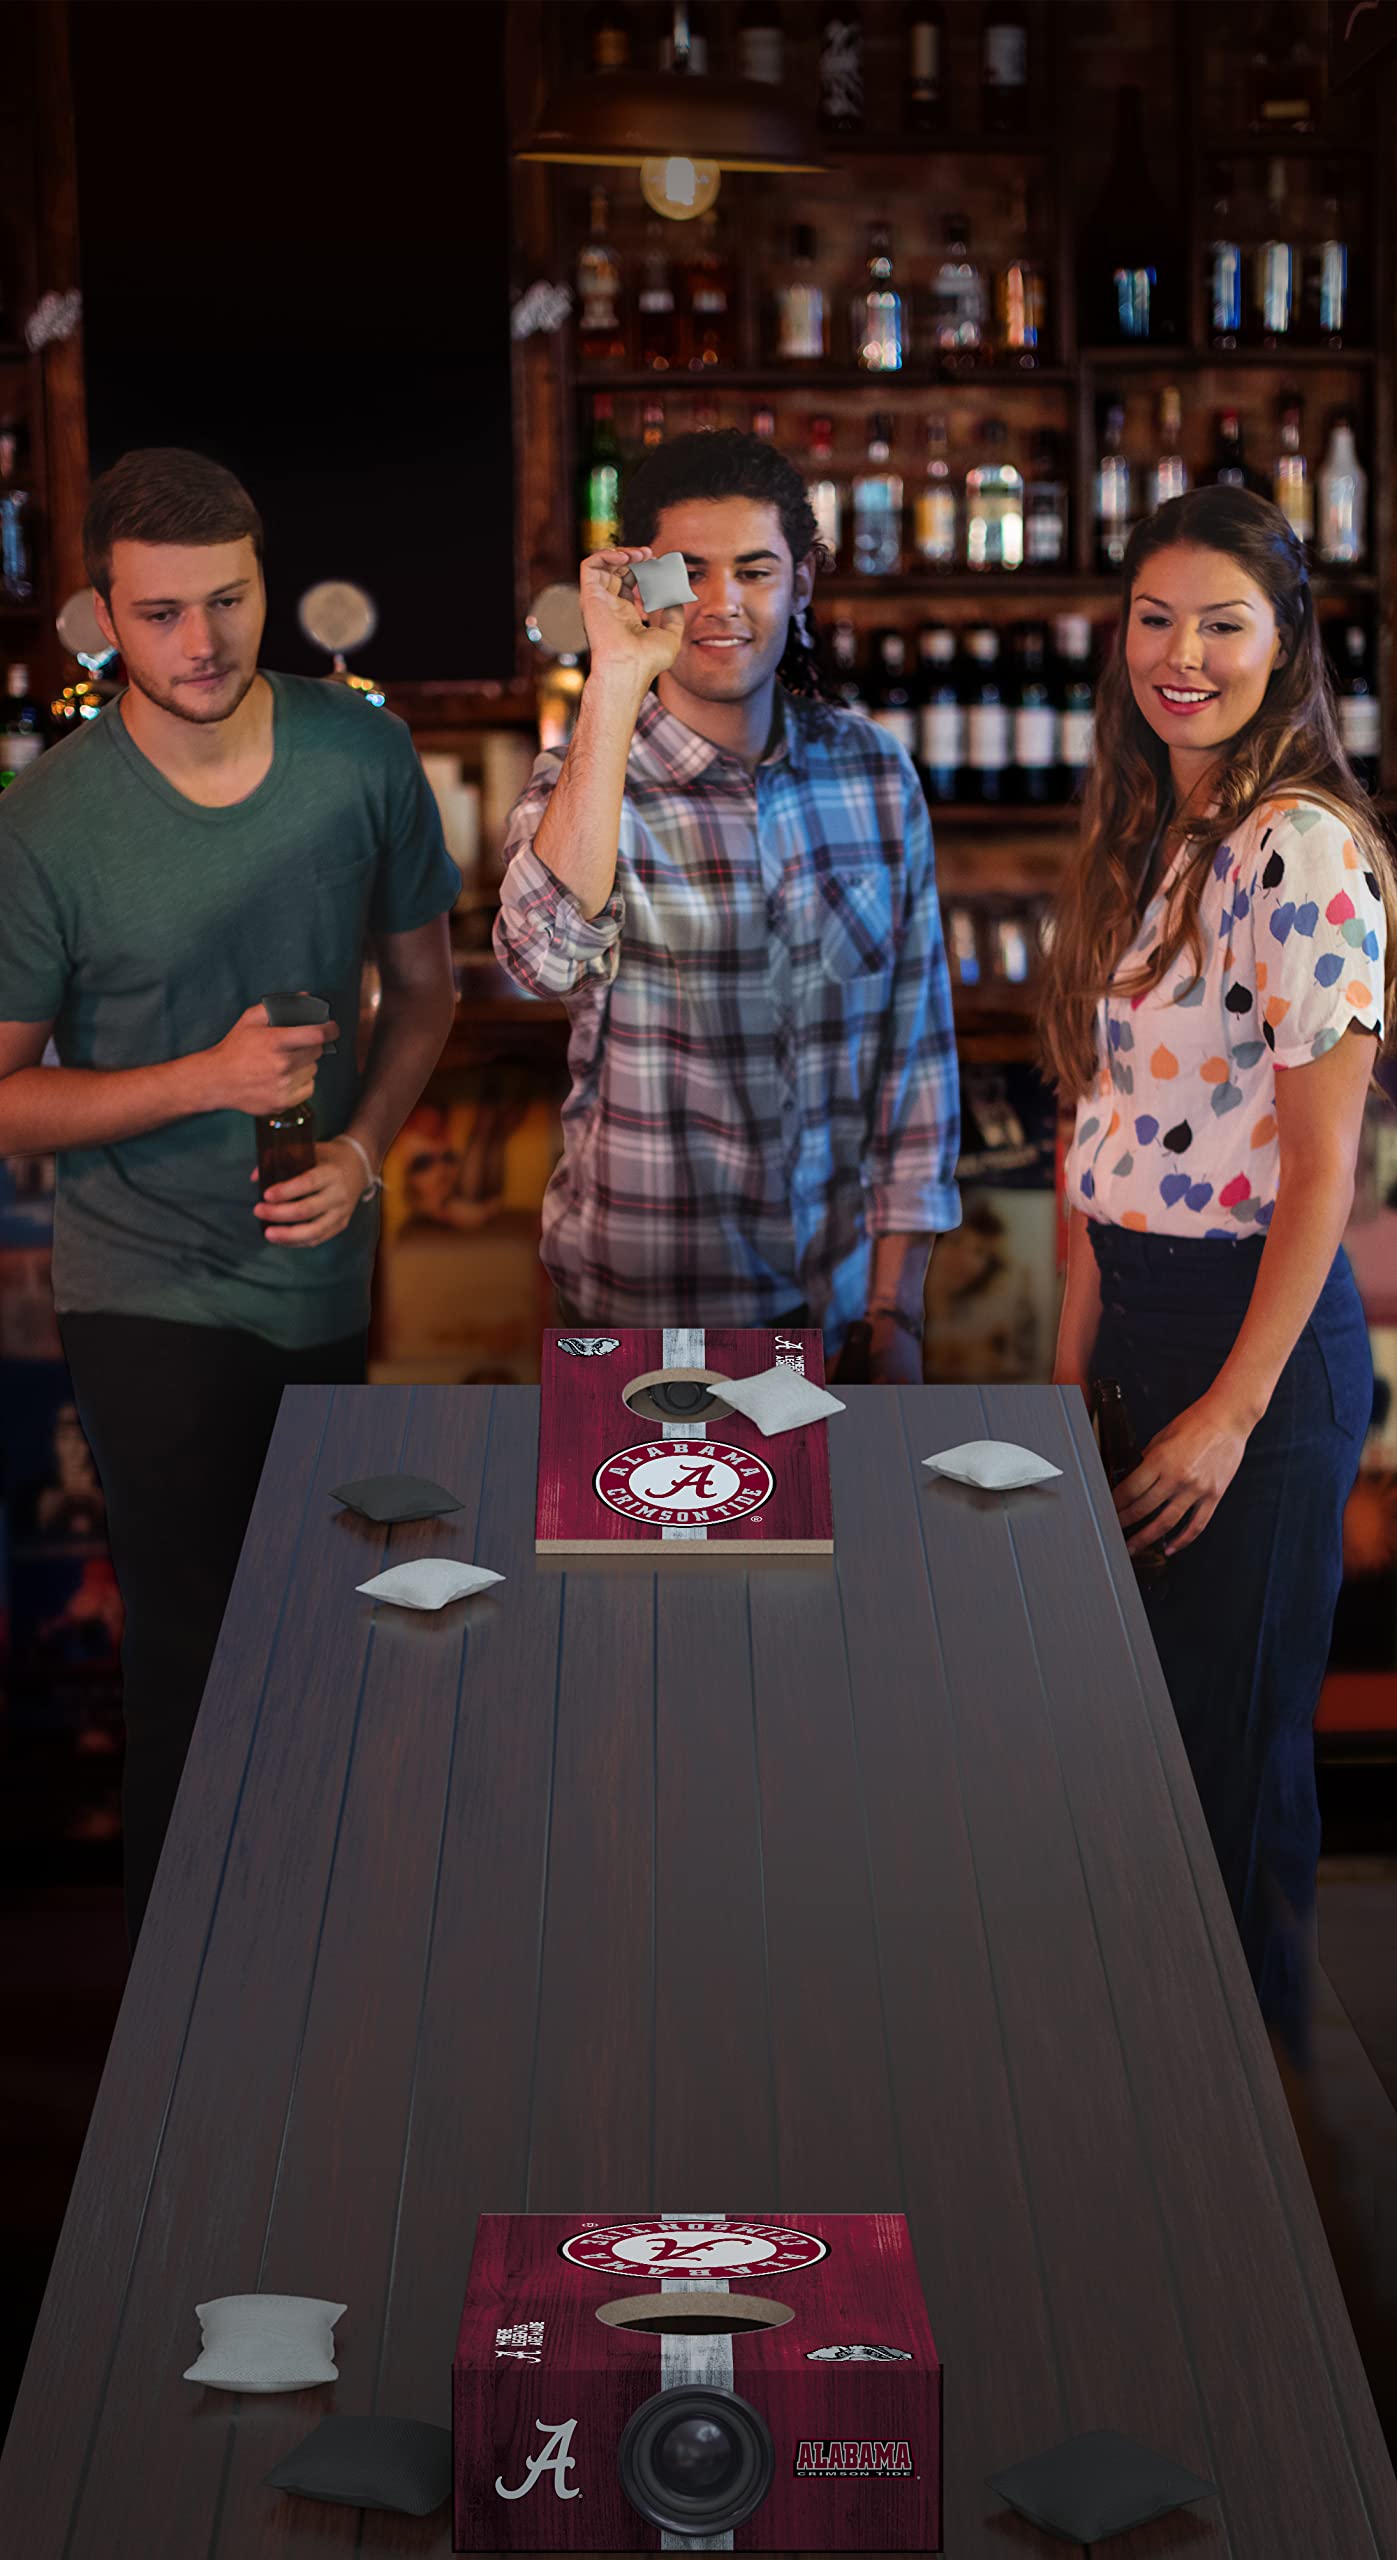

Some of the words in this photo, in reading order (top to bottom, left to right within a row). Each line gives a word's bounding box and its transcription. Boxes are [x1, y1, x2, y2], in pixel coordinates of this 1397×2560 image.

[608, 1444, 761, 1477] ALABAMA
[644, 1464, 718, 1499] A
[606, 1487, 710, 1522] CRIMSON
[713, 1488, 763, 1517] TIDE
[580, 2224, 652, 2246] TIDE
[657, 2223, 809, 2246] CRIMSON
[580, 2252, 809, 2277] ALABAMA
[495, 2418, 580, 2500] A
[796, 2441, 912, 2470] ALABAMA
